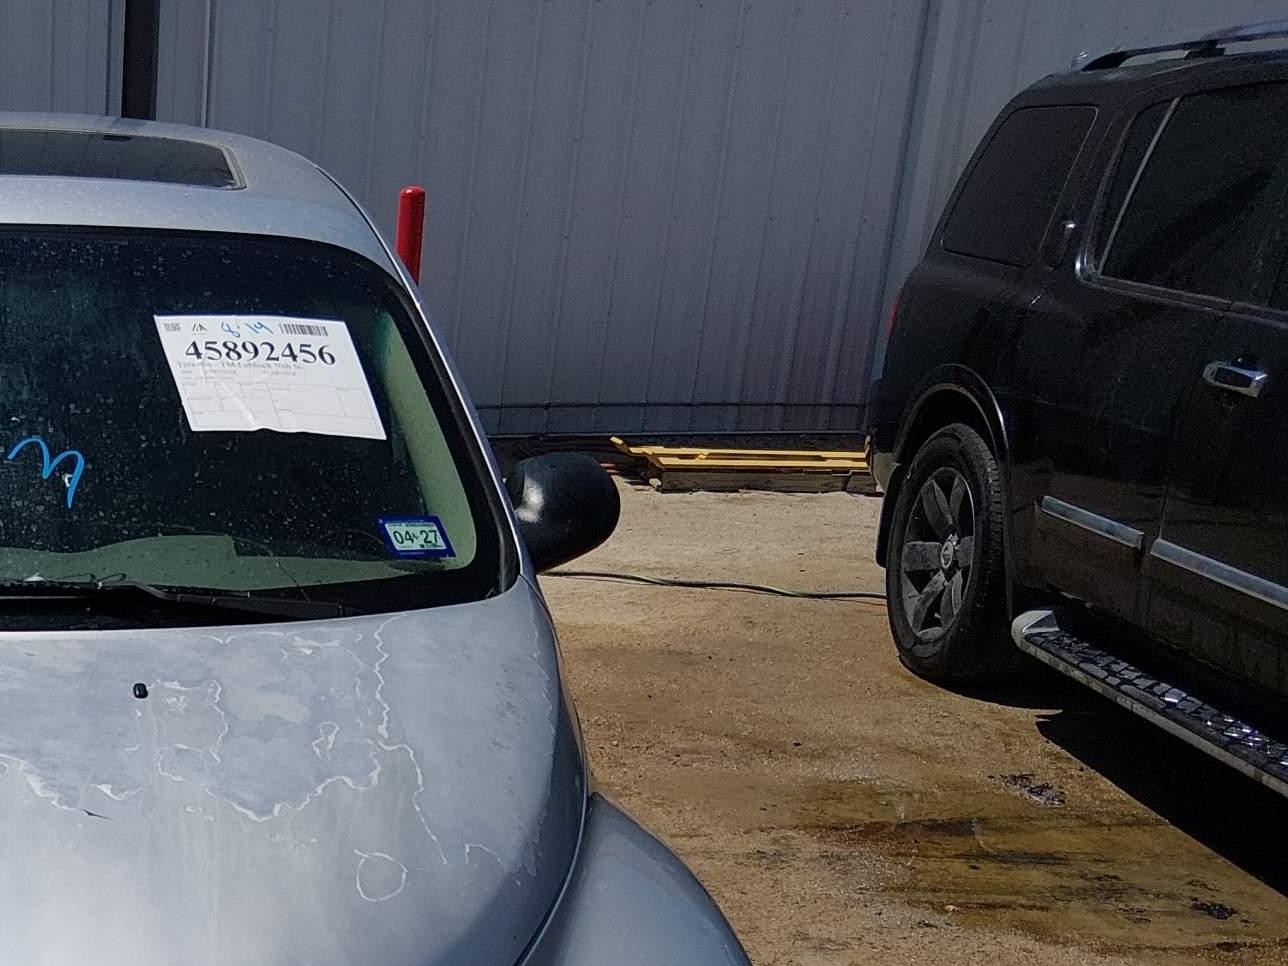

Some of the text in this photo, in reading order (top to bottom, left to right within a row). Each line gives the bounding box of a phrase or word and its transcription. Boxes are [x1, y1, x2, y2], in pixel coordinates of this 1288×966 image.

[185, 340, 336, 366] 45892456
[392, 529, 438, 545] 04 27
